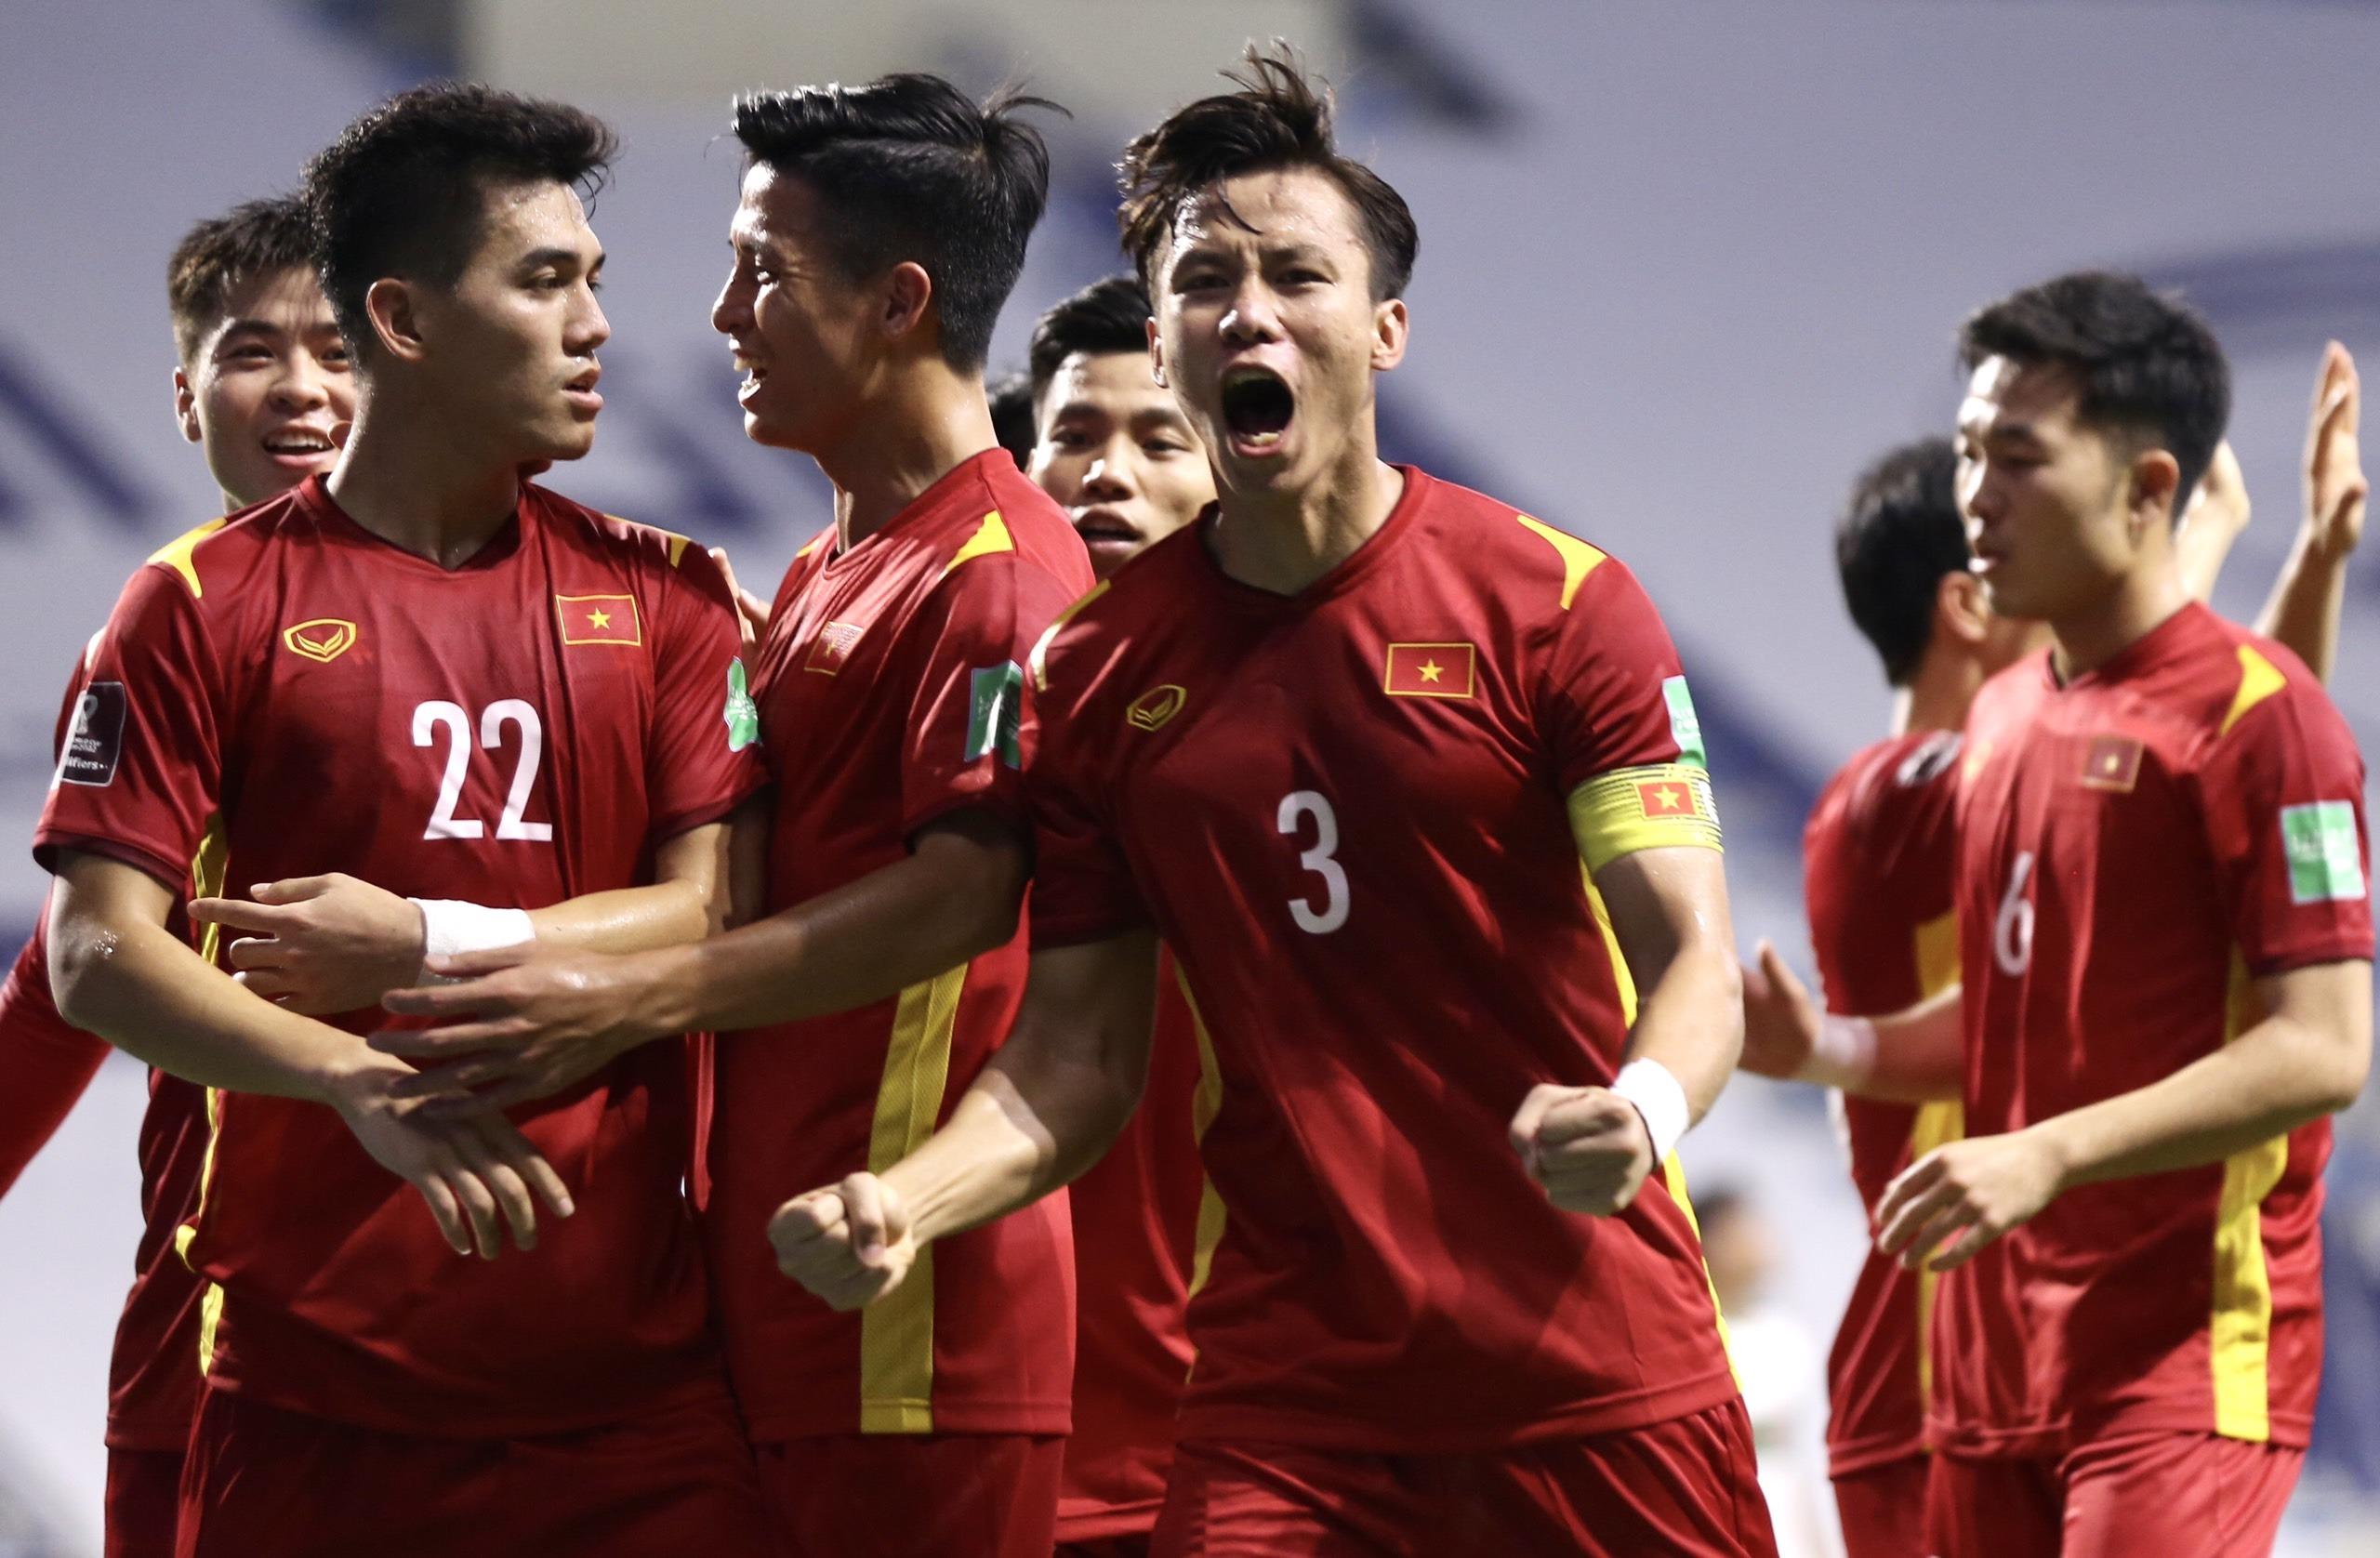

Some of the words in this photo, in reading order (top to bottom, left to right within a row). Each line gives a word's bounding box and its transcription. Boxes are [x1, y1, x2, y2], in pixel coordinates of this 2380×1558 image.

[412, 699, 553, 841] 22
[1276, 790, 1350, 934] 3
[1994, 851, 2035, 976] 6
